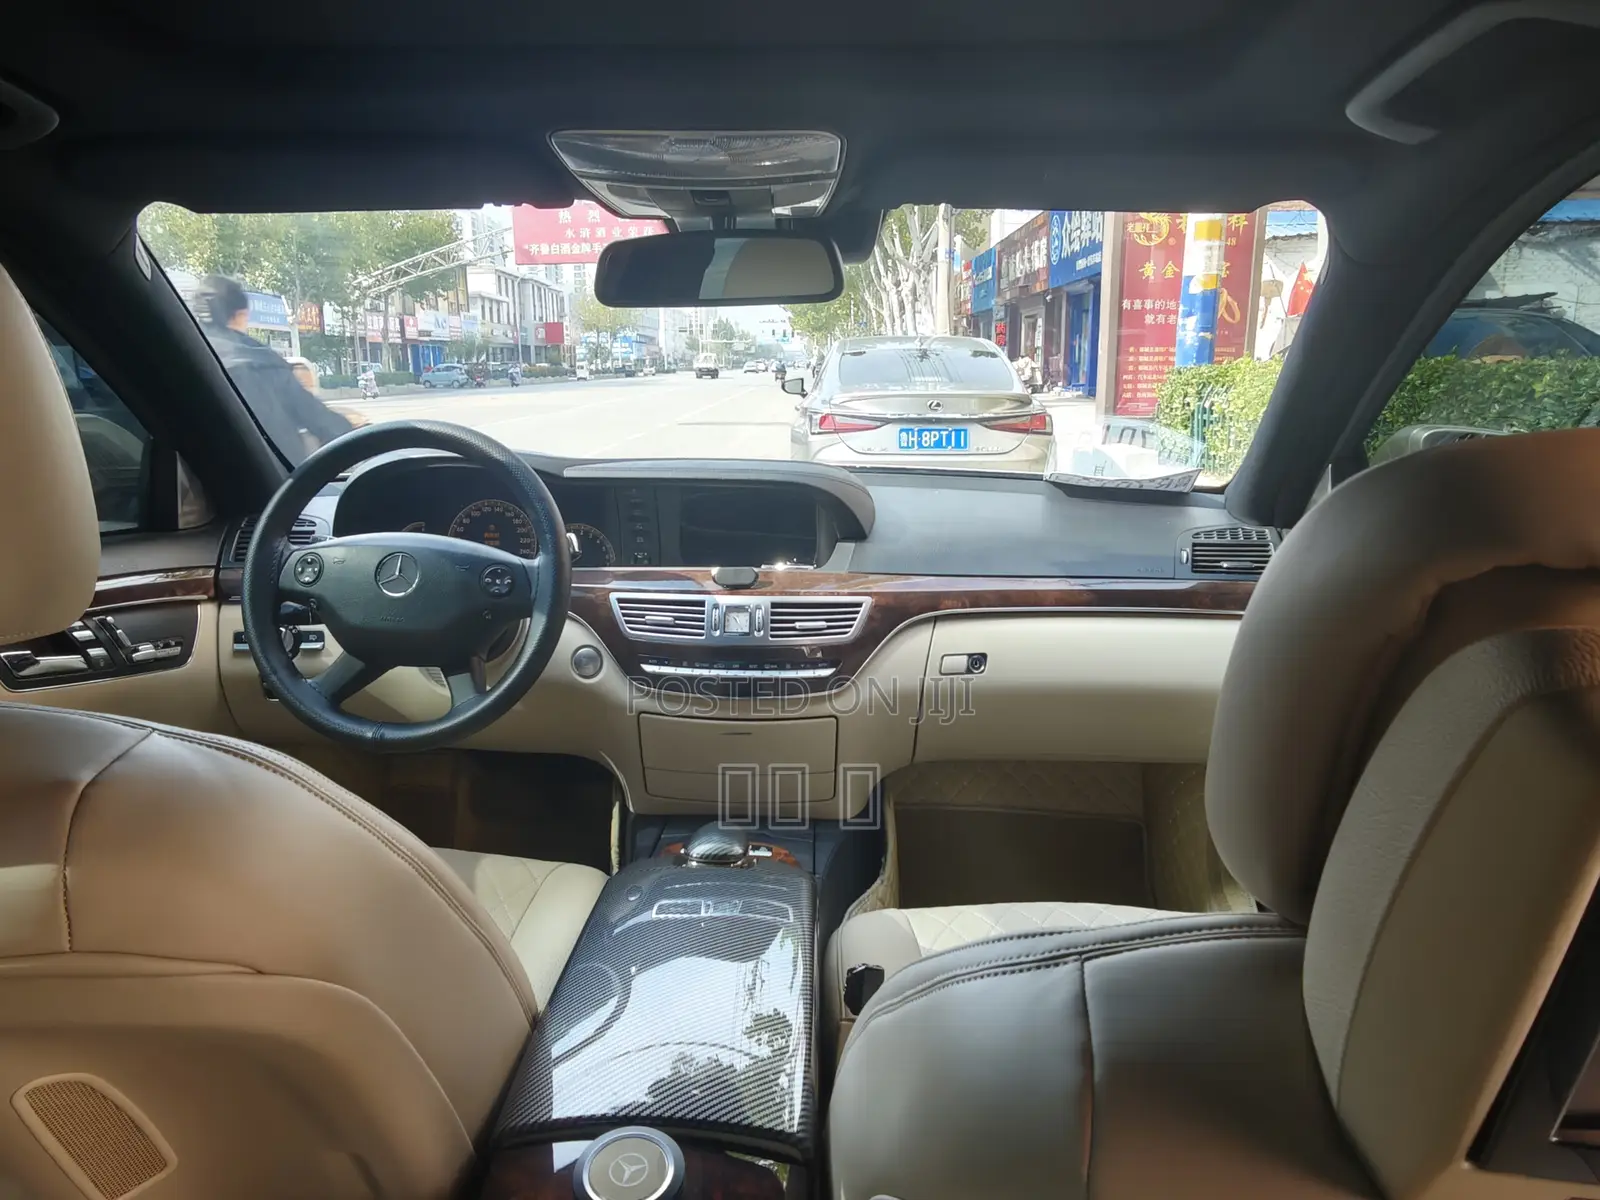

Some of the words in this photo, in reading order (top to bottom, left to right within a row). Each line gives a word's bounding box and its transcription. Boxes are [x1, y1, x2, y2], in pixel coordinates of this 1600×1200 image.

[1122, 299, 1182, 311] 有喜事的地
